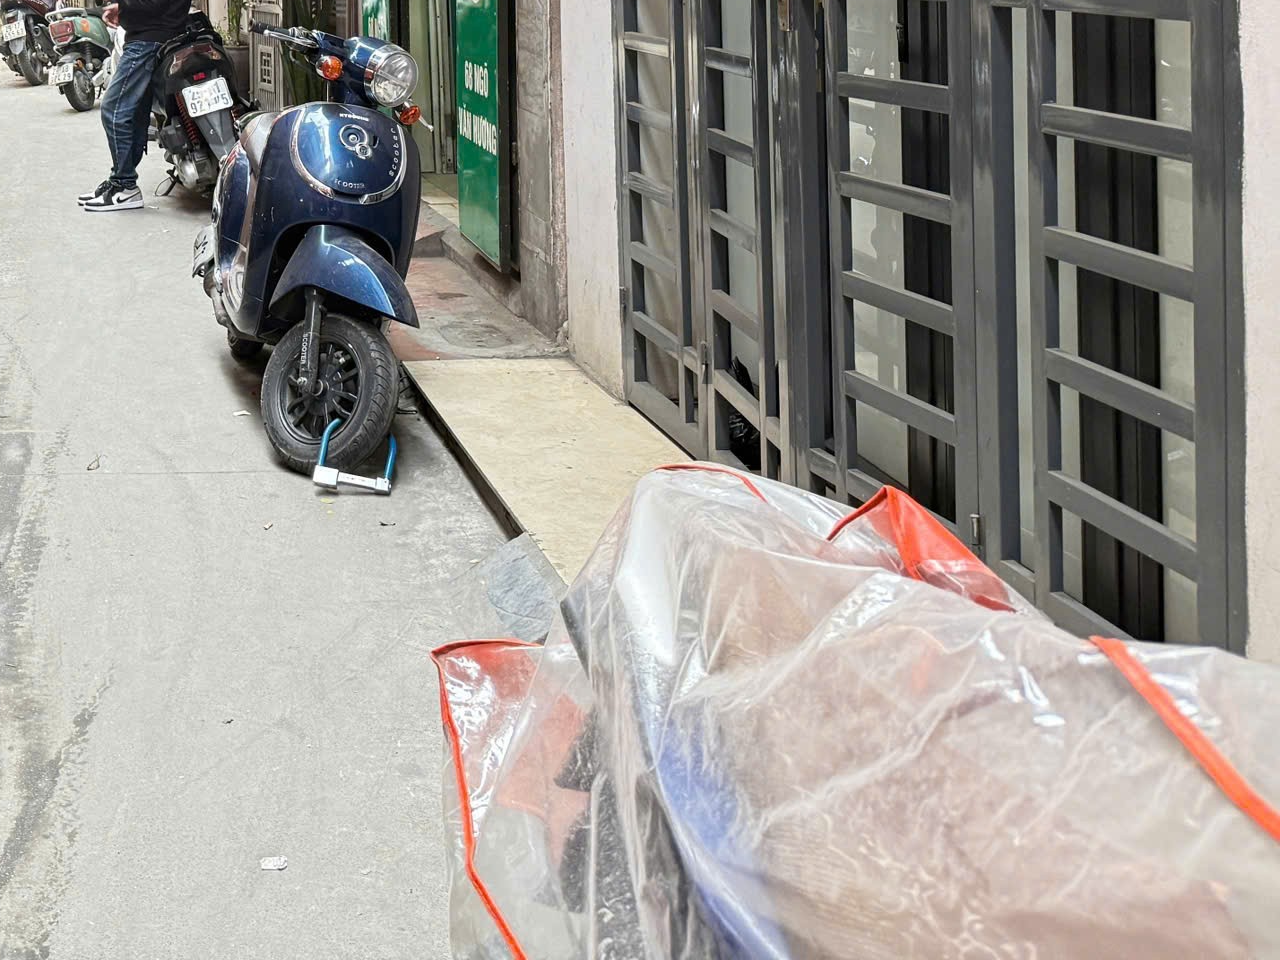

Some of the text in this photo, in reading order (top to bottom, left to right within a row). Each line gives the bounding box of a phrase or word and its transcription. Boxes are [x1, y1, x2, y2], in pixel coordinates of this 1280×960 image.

[464, 60, 473, 91] 68
[458, 103, 497, 156] VĂN HƯƠNG
